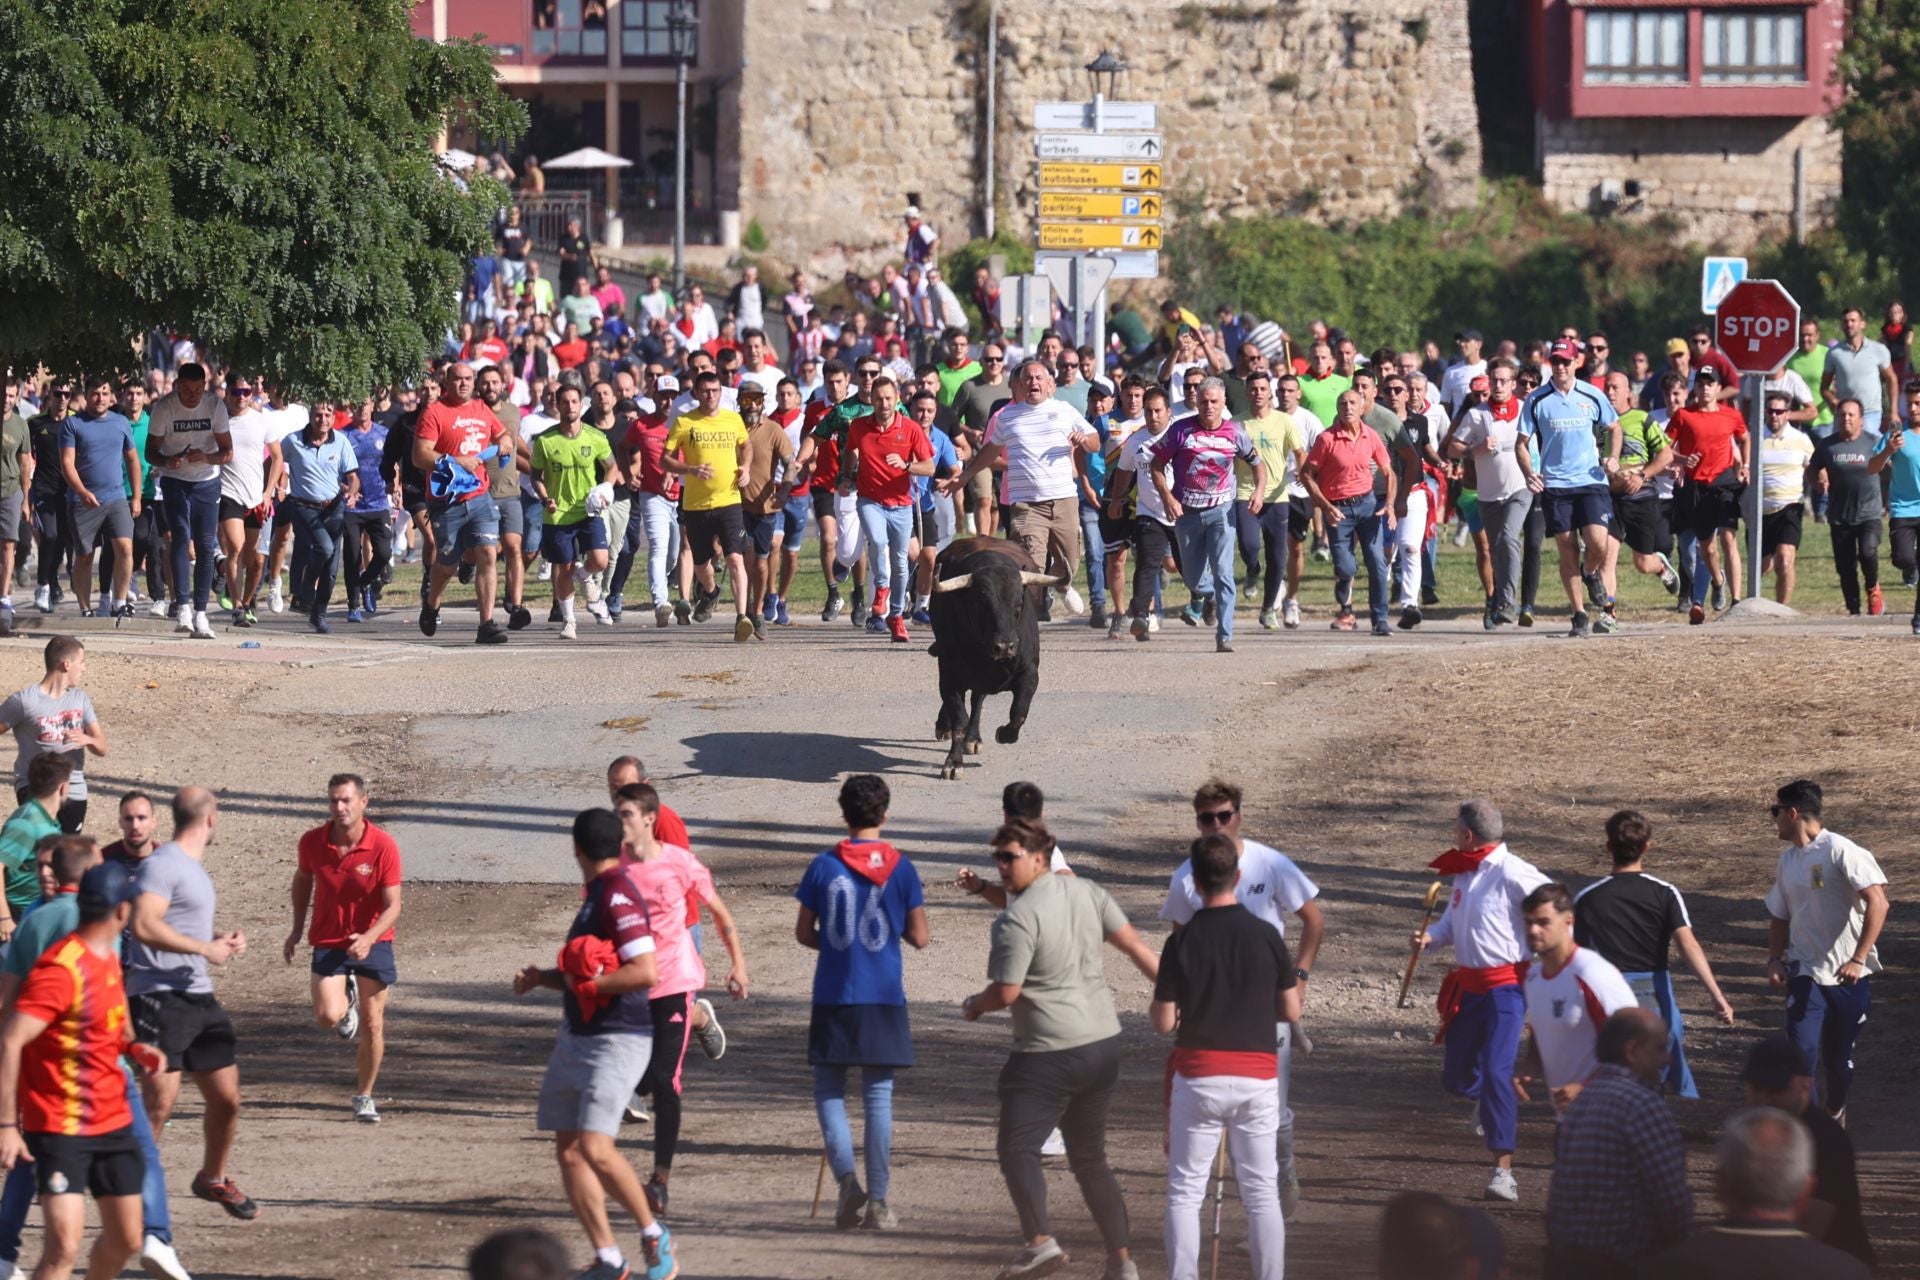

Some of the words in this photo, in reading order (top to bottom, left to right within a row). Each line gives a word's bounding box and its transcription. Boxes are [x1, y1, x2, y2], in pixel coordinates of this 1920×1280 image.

[1043, 145, 1079, 154] urbano
[1043, 175, 1098, 184] autobuses
[1043, 204, 1083, 214] parking
[1043, 235, 1084, 244] turismo
[1723, 315, 1790, 338] STOP
[174, 421, 201, 430] TRAIN
[827, 875, 890, 952] 06
